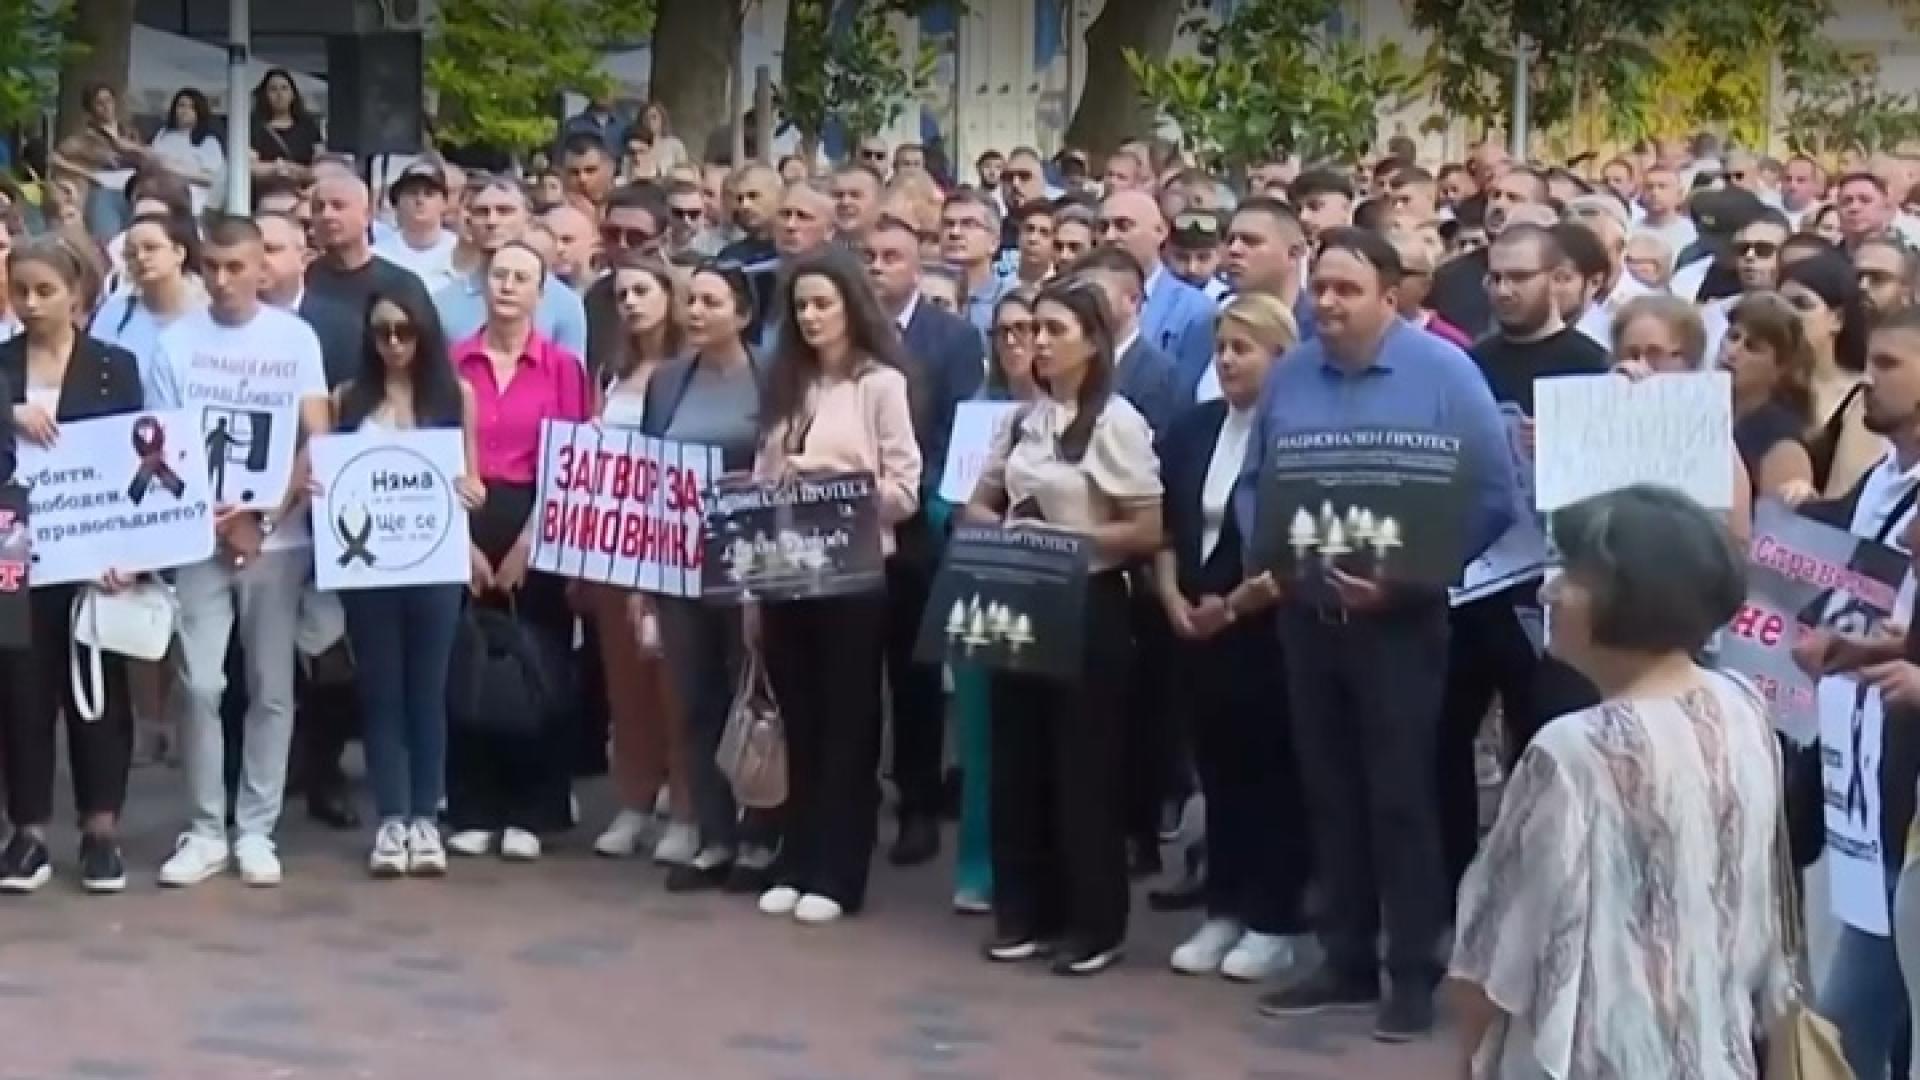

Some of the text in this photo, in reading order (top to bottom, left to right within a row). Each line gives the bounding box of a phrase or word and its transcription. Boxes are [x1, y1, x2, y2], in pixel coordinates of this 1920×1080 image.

[371, 469, 433, 491] Няма
[555, 445, 704, 517] ЗАТВОР ЗА
[375, 513, 436, 532] Ще се
